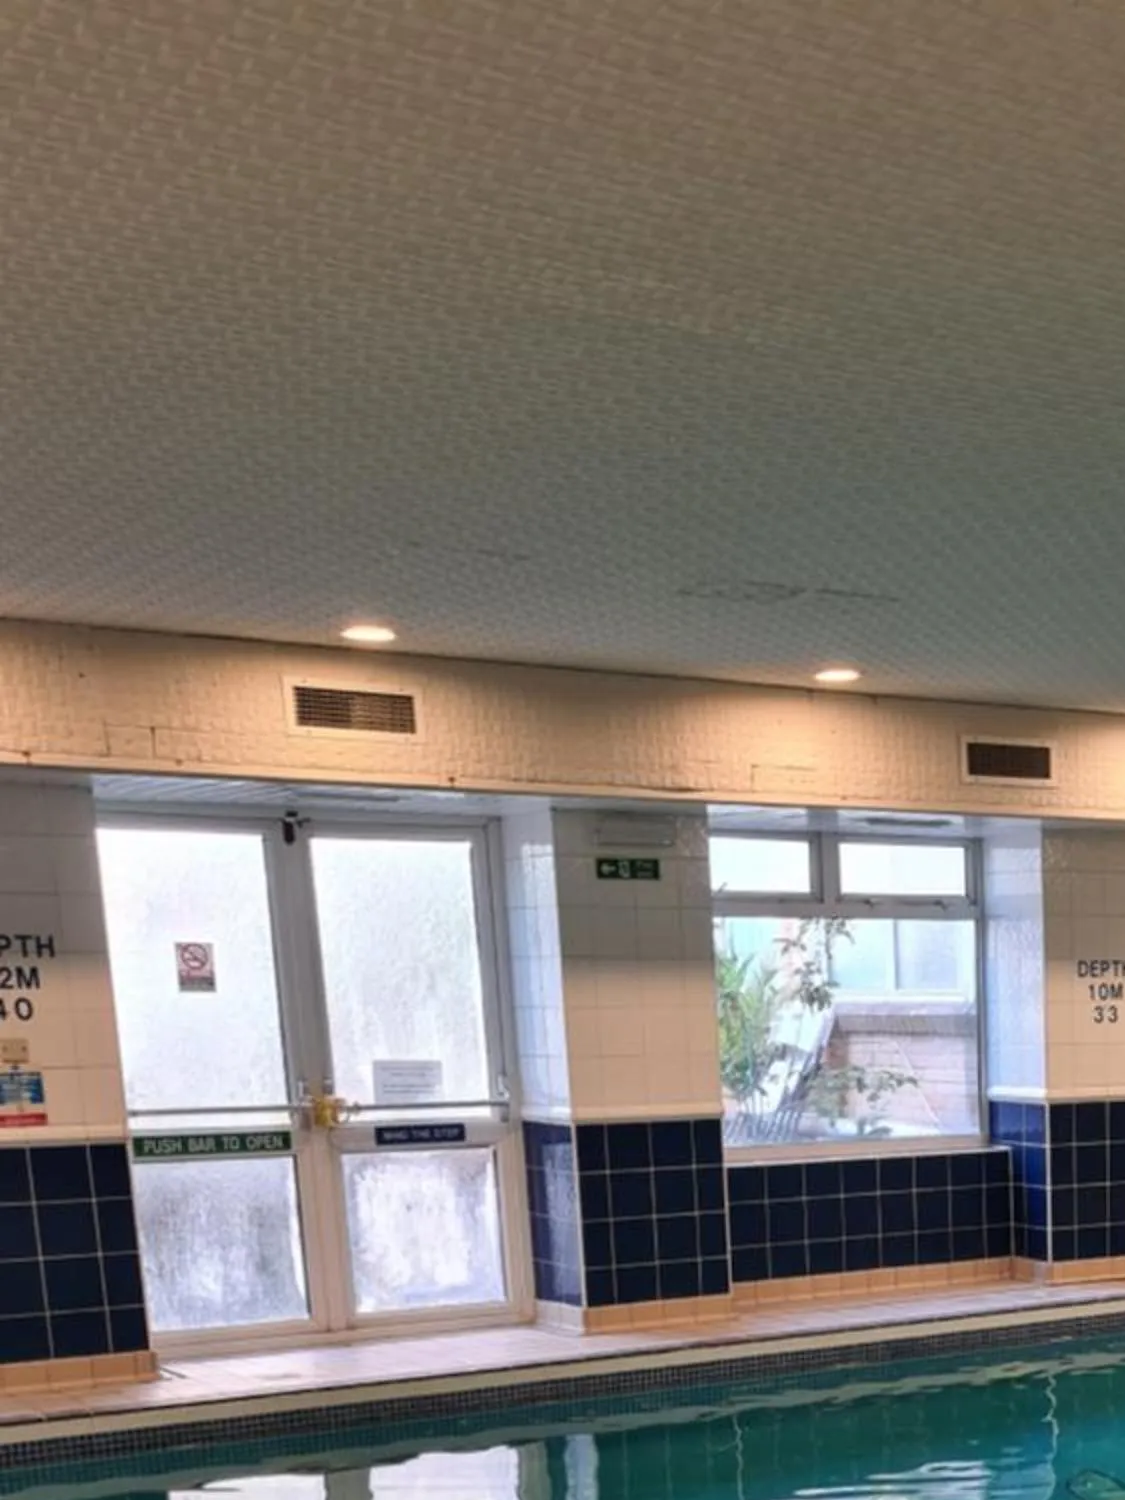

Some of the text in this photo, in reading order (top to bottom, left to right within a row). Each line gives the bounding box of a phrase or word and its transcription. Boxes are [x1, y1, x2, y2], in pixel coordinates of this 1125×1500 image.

[143, 1134, 285, 1154] PUSH BAR TO OPEN
